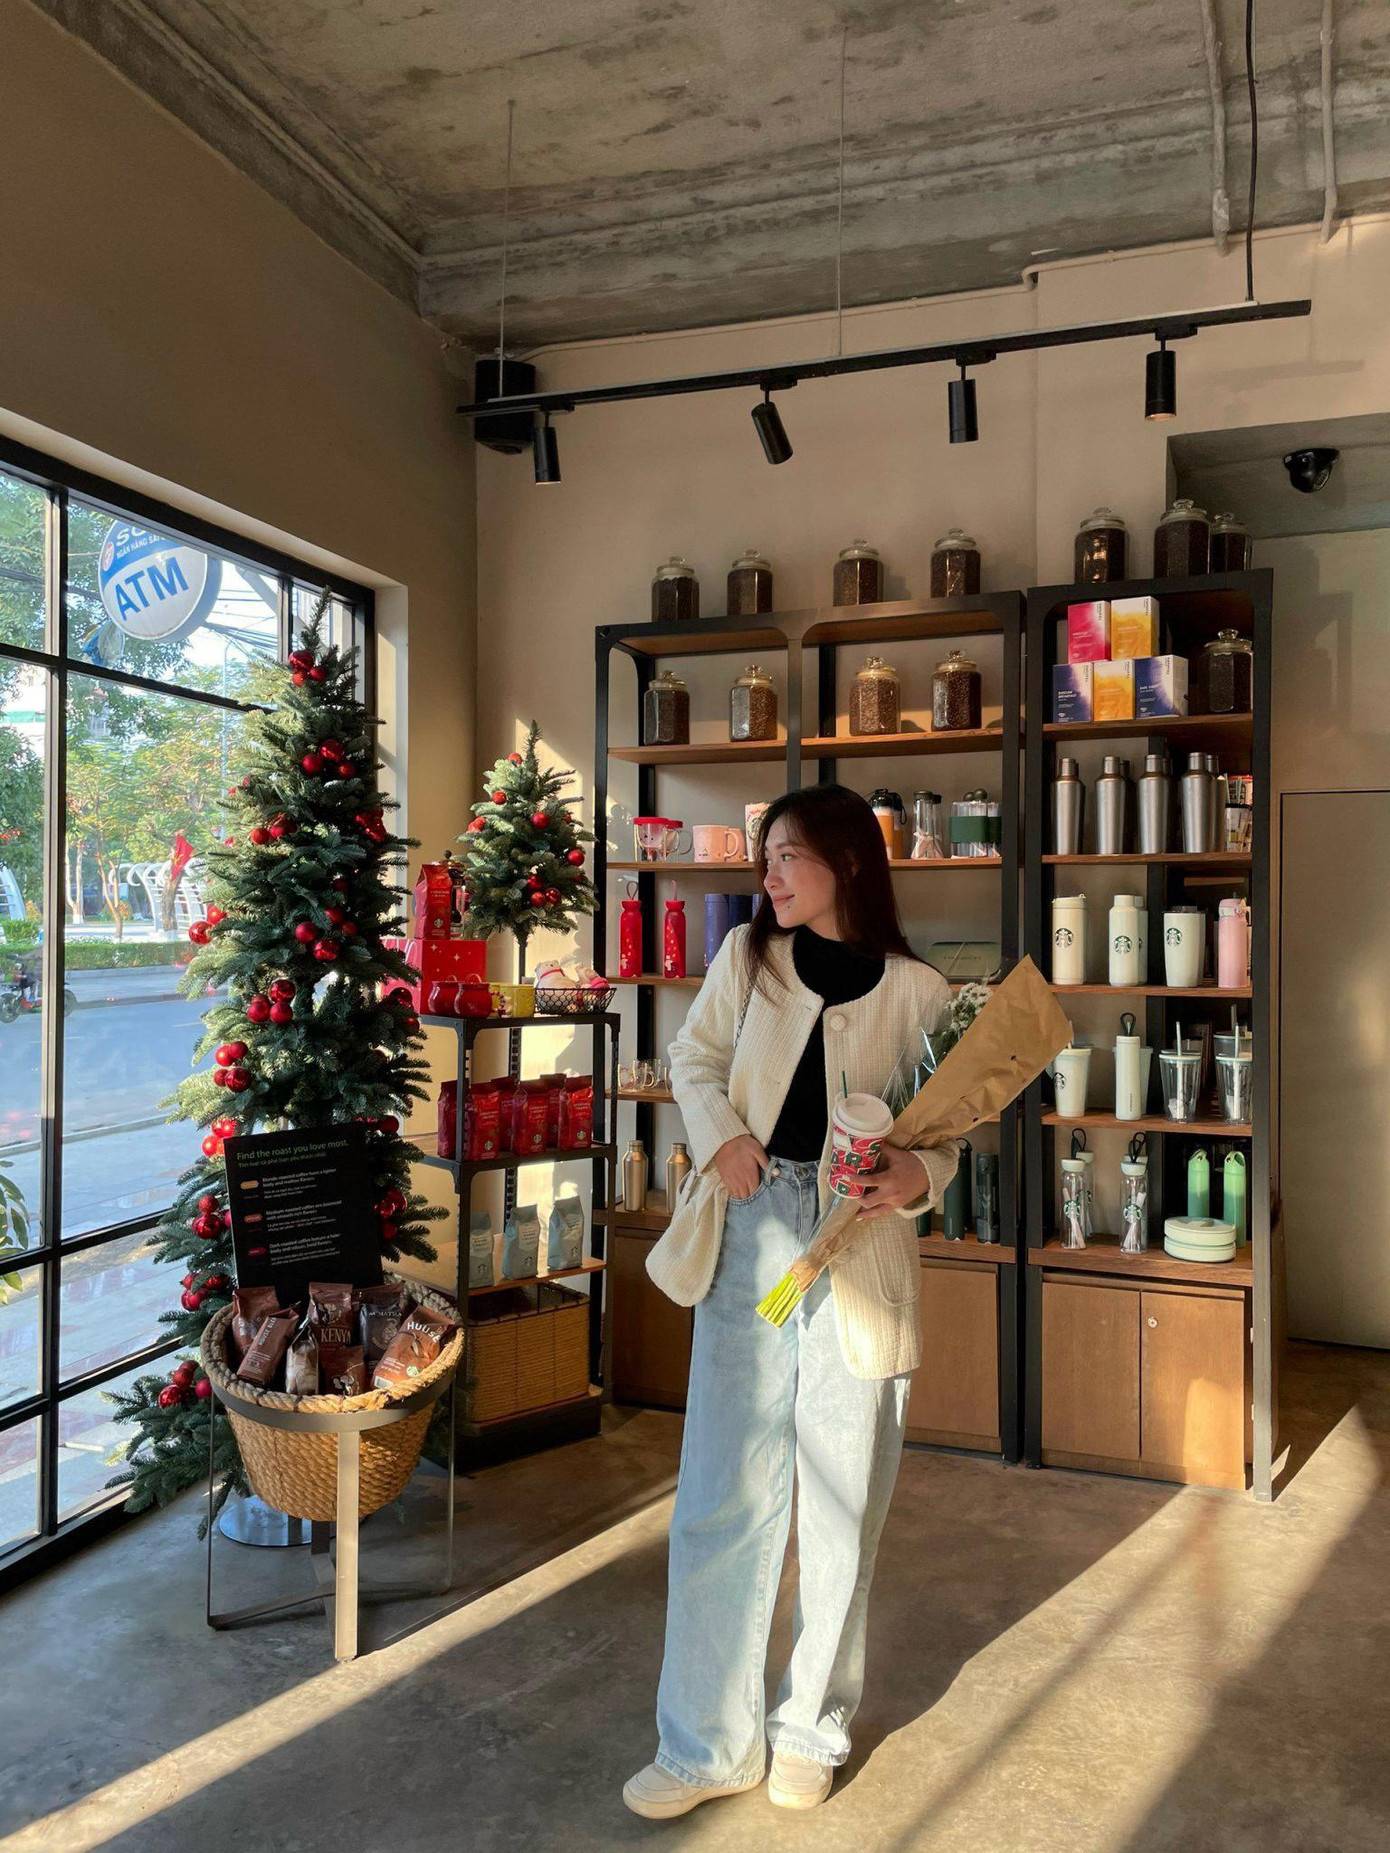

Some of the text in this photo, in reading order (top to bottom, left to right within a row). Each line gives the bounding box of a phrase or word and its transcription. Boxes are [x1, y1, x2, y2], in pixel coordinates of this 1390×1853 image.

[115, 556, 189, 621] ATM
[236, 1151, 255, 1161] Find
[256, 1149, 270, 1158] the
[271, 1146, 292, 1156] roast
[293, 1144, 309, 1155] you
[309, 1142, 326, 1151] love
